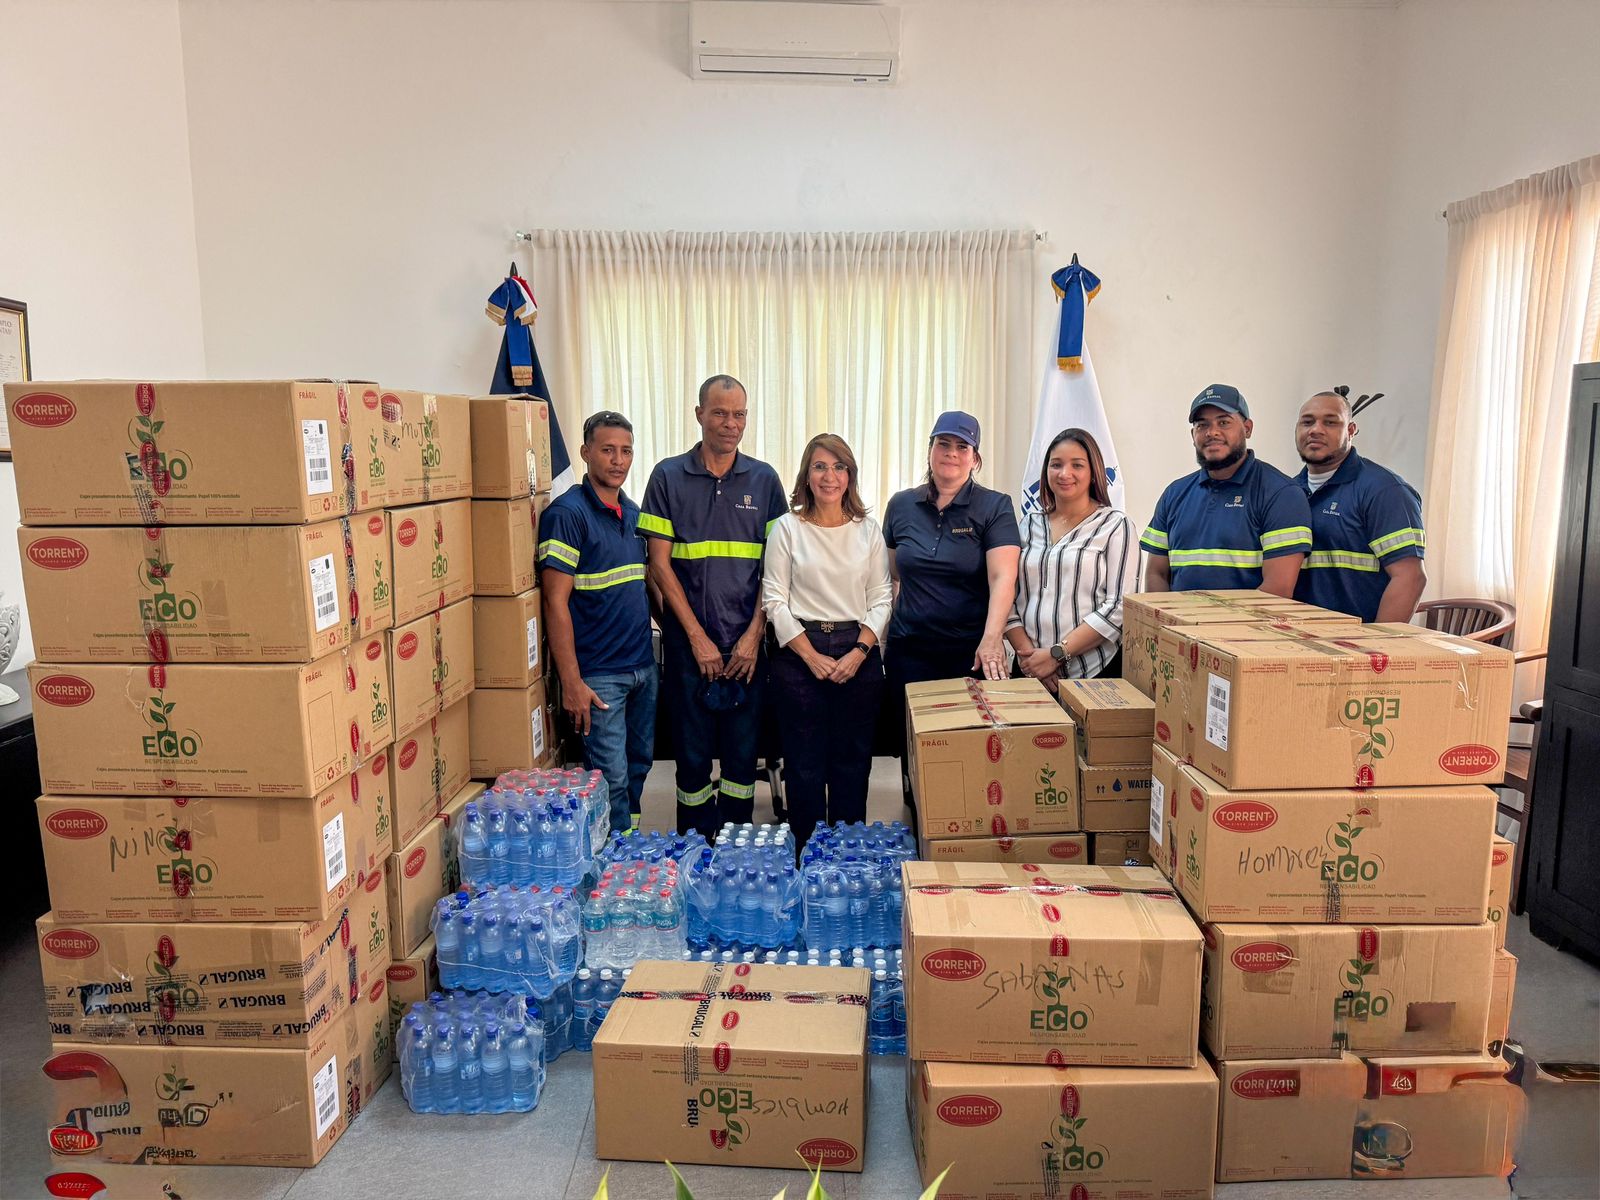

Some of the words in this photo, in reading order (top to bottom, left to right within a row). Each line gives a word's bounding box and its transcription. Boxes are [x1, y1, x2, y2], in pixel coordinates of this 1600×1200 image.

[299, 391, 317, 399] FRÁGIL
[19, 404, 69, 416] TORRENT
[369, 458, 385, 478] ECO
[305, 531, 323, 541] FRÁGIL
[32, 548, 82, 559] TORRENT
[432, 555, 448, 578] ECO
[373, 581, 389, 602] ECO
[42, 684, 88, 696] TORRENT
[371, 702, 388, 724] ECO
[1345, 697, 1400, 724] ECO
[142, 731, 198, 758] ECO
[1035, 736, 1066, 744] TORRENT
[1444, 755, 1494, 766] TORRENT
[1127, 779, 1154, 790] WATER
[1035, 788, 1068, 806] ECO
[1219, 811, 1271, 822] TORRENT
[52, 820, 100, 829] TORRENT
[1321, 856, 1379, 883] ECO
[49, 939, 93, 951] TORRENT
[369, 928, 386, 954] ECO
[928, 959, 980, 970] TORRENT
[209, 968, 267, 984] BRUGAL
[95, 1001, 151, 1015] BRUGAL
[233, 994, 287, 1008] BRUGAL
[285, 1003, 326, 1034] BRUGAL
[691, 999, 712, 1031] BRUGAL
[1030, 1004, 1088, 1031] ECO
[148, 1024, 205, 1037] BRUGAL
[699, 1088, 753, 1113] ECO
[686, 1098, 698, 1126] BRU
[944, 1105, 994, 1116] TORRENT
[803, 1150, 850, 1160] TORRENT
